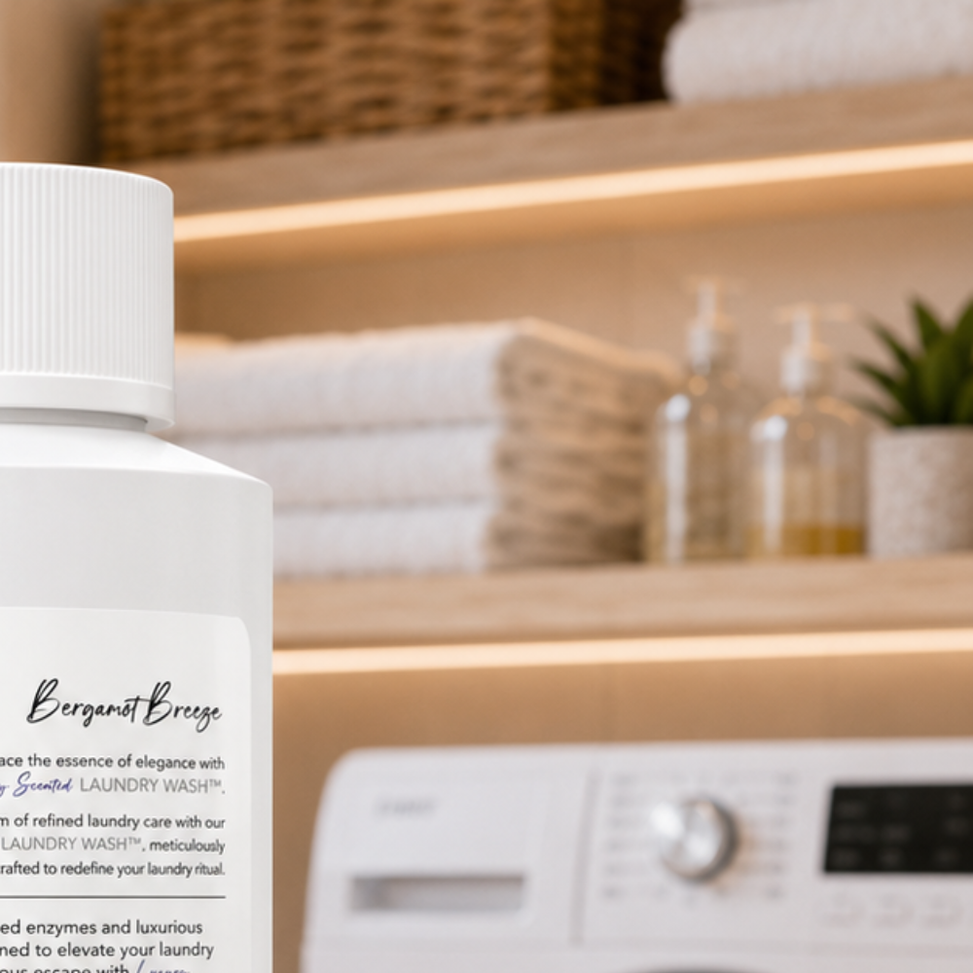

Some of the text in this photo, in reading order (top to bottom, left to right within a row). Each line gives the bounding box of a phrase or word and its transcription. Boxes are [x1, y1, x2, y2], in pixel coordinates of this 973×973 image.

[26, 678, 222, 733] Bergamot Breeze
[27, 753, 52, 767] the
[56, 757, 114, 768] essence
[117, 753, 132, 768] of
[135, 755, 196, 772] elegance
[199, 756, 225, 770] with
[80, 777, 159, 792] LAUNDRY
[14, 813, 29, 827] of
[33, 813, 83, 827] refined
[88, 813, 140, 831] laundry
[143, 818, 172, 828] care
[175, 815, 202, 829] with
[204, 819, 225, 829] our
[1, 836, 77, 851] LAUNDRY
[149, 838, 226, 855] meticulously
[43, 863, 58, 875] to
[60, 861, 114, 875] redefine
[117, 865, 145, 878] your
[147, 862, 193, 878] laundry
[195, 862, 225, 875] ritual.
[26, 923, 97, 938] enzymes
[101, 919, 131, 934] and
[136, 919, 203, 935] luxurious
[35, 944, 52, 957] to
[57, 941, 115, 957] elevate
[120, 946, 156, 961] your
[159, 941, 214, 960] laundry
